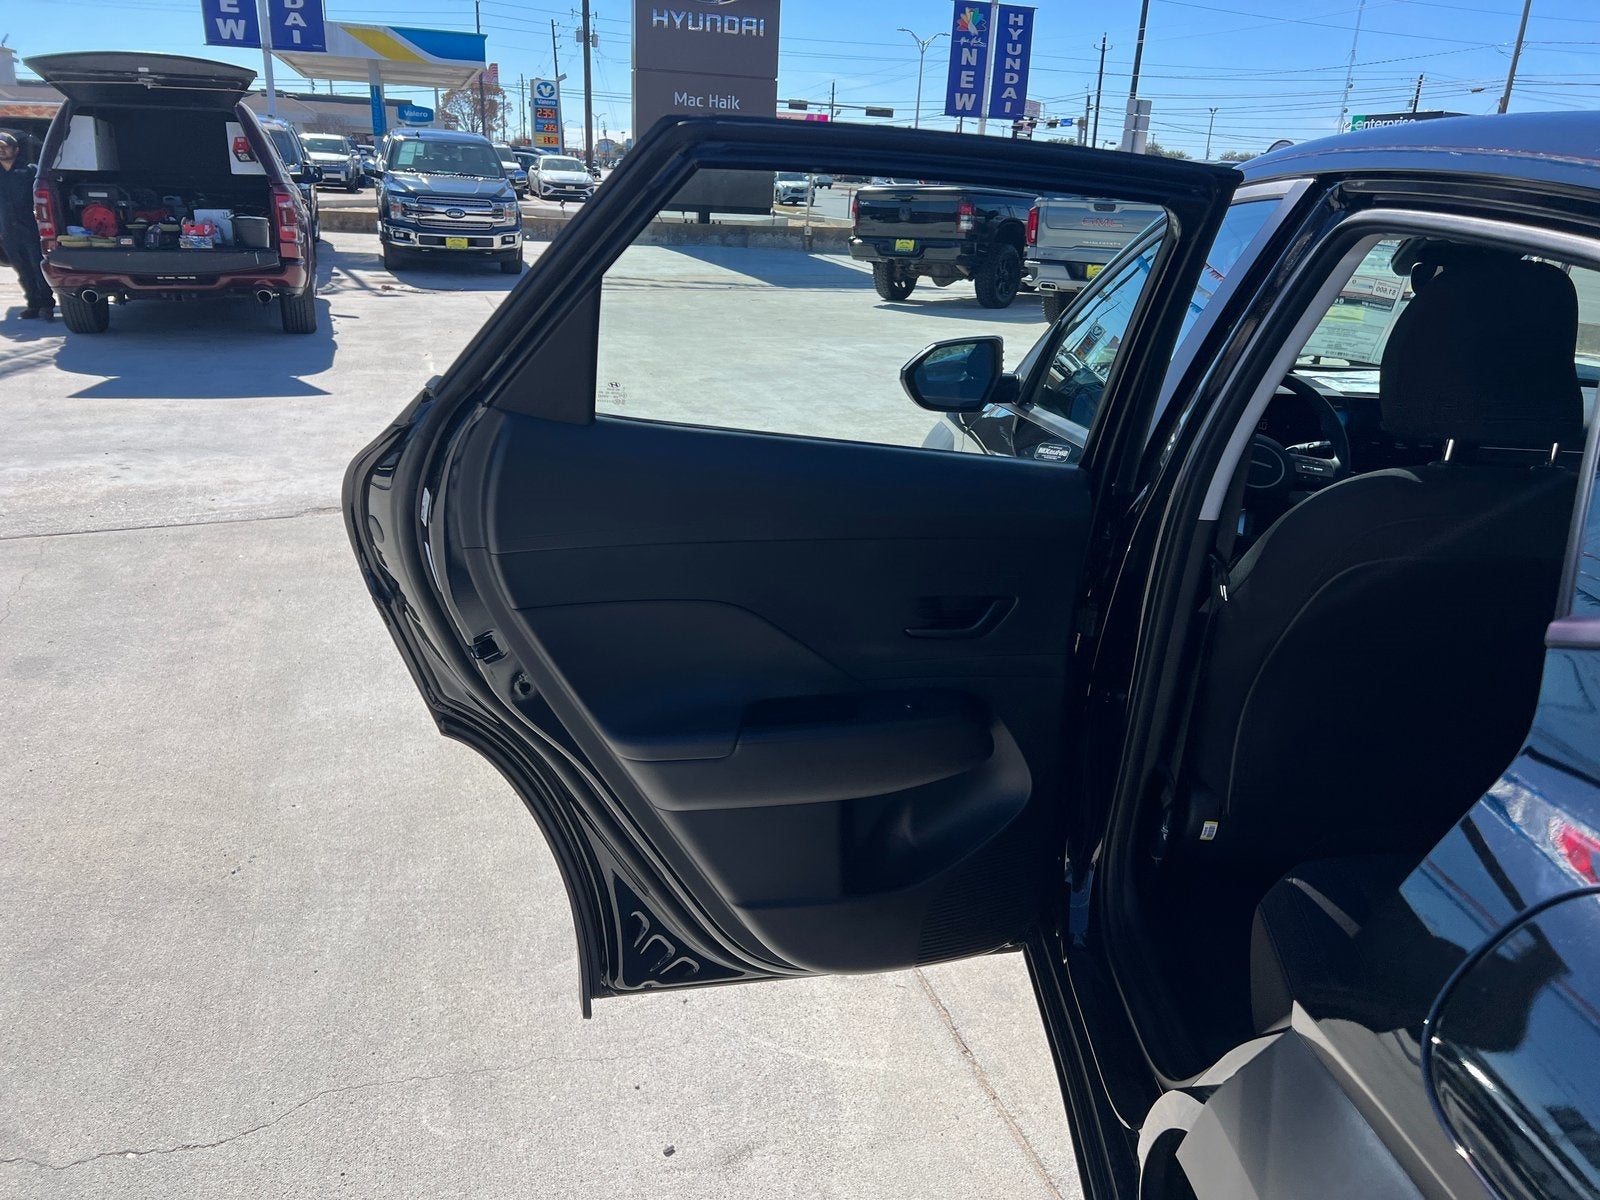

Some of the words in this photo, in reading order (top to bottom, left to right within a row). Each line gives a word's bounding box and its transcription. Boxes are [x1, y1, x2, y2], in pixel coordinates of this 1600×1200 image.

[652, 8, 765, 37] HYUNDAI
[1001, 13, 1025, 113] HYUNDAI
[955, 47, 978, 111] NEW
[404, 109, 428, 118] Valero
[674, 91, 704, 107] Mac
[708, 94, 740, 110] Haik
